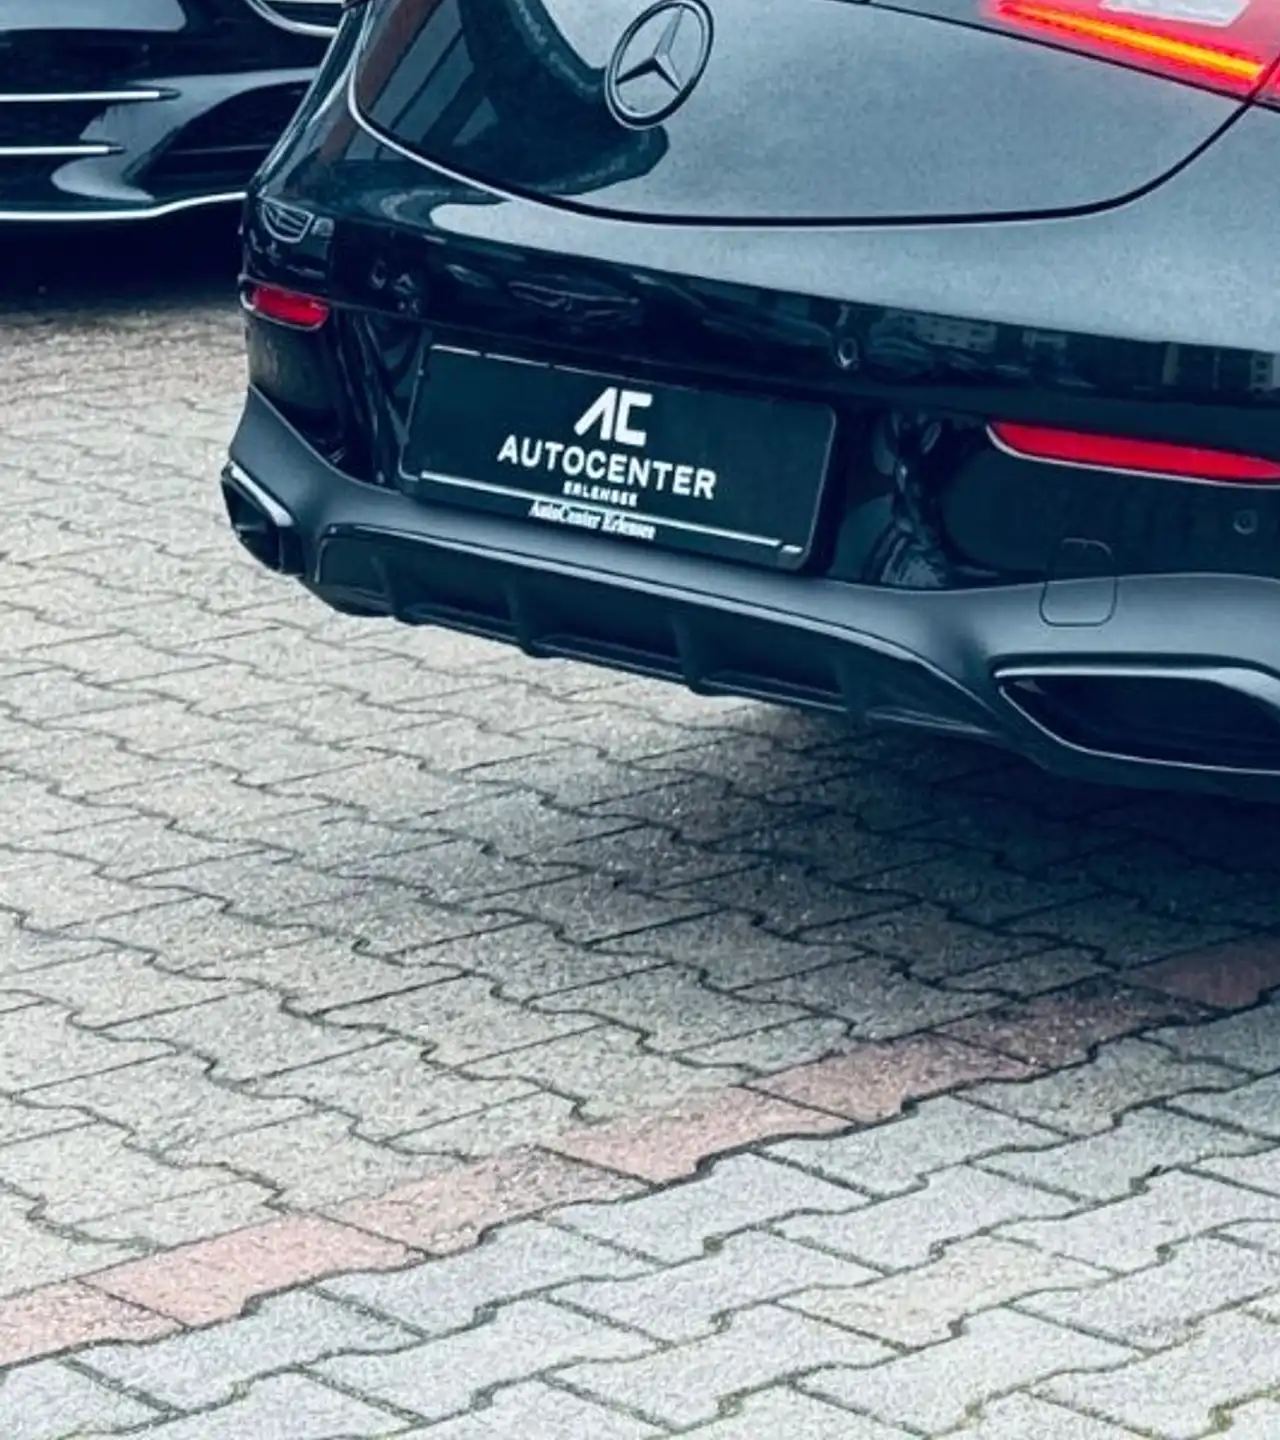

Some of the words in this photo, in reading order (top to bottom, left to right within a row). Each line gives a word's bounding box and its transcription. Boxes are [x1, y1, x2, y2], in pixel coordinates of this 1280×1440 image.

[574, 387, 653, 446] AC
[497, 435, 716, 500] AUTOCENTER
[562, 480, 639, 507] ERLENSEE
